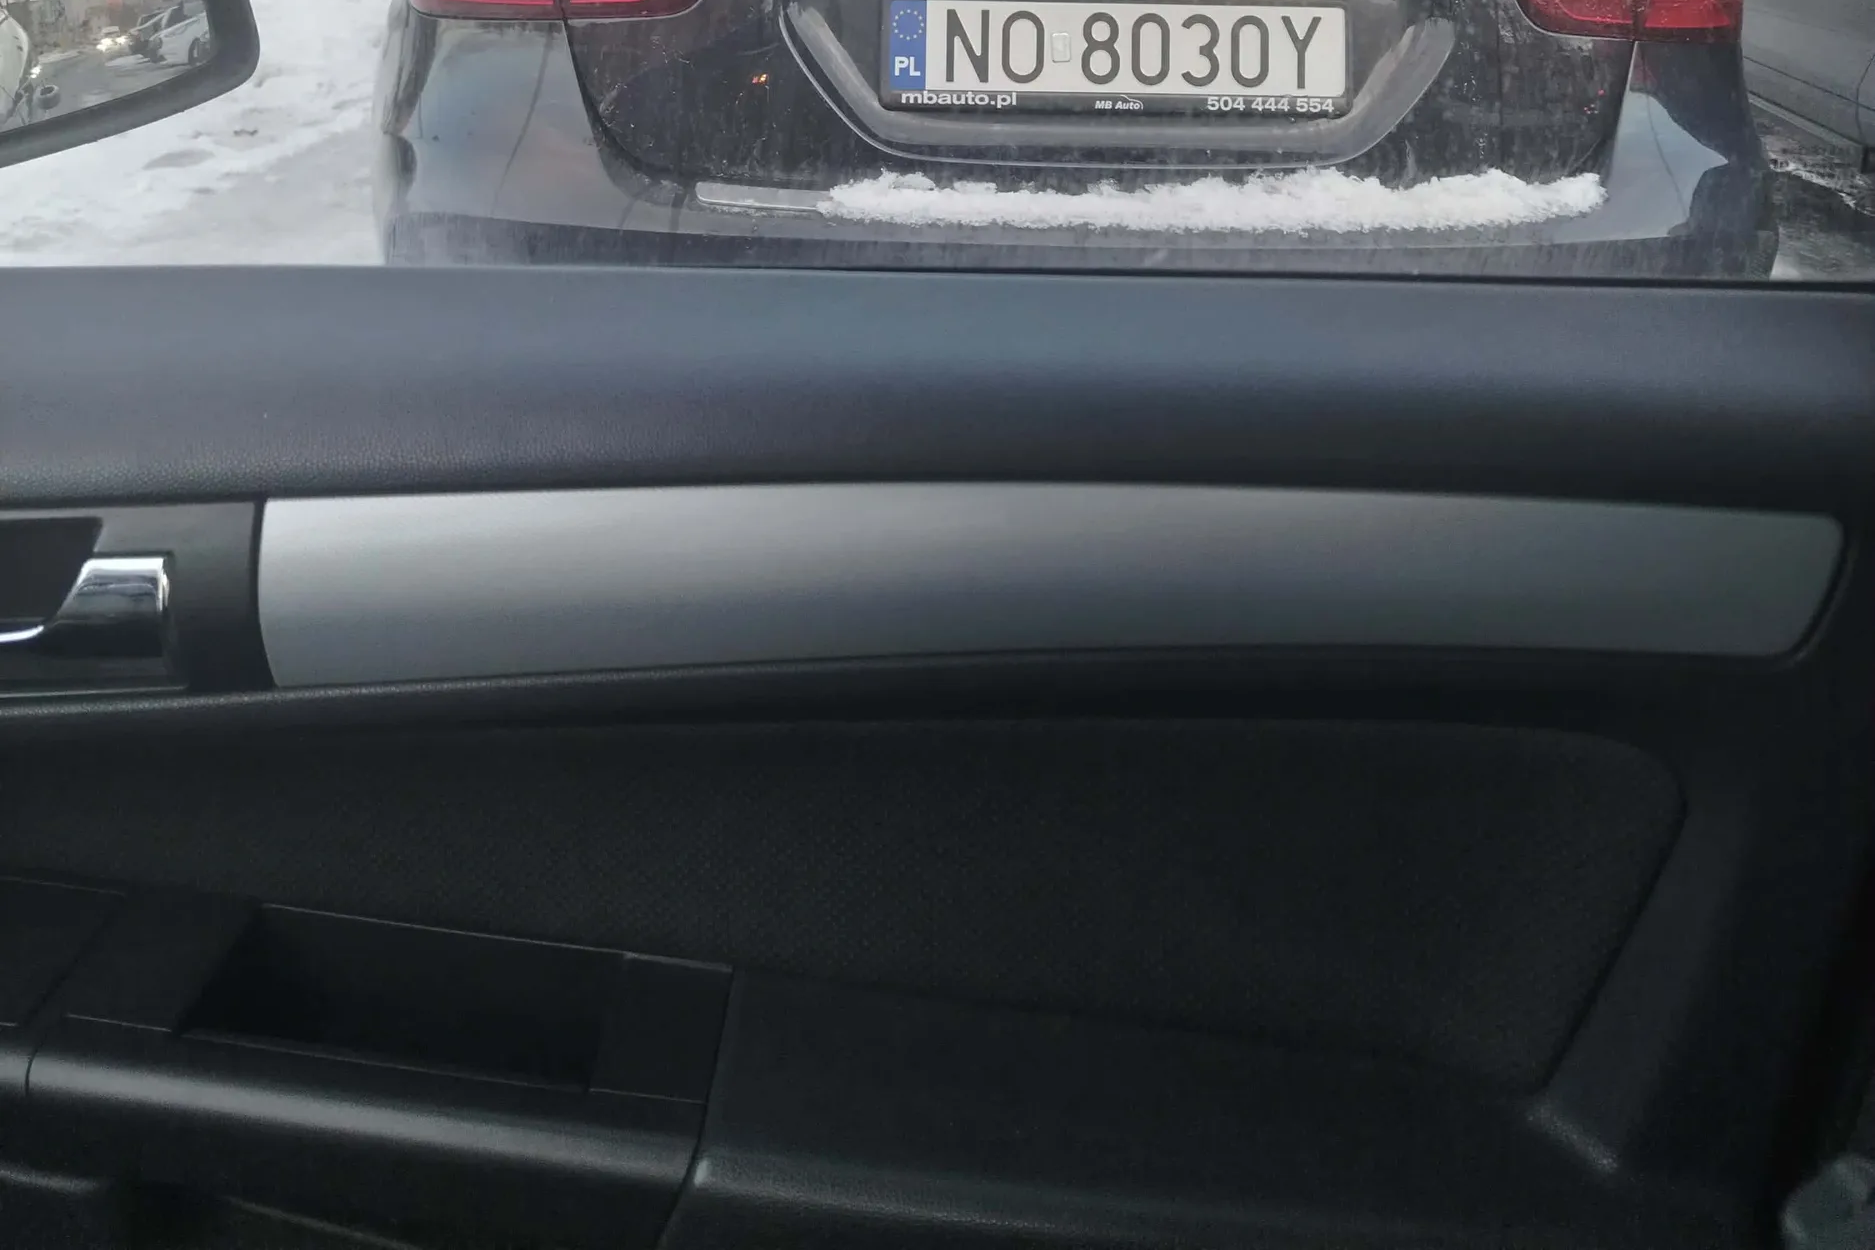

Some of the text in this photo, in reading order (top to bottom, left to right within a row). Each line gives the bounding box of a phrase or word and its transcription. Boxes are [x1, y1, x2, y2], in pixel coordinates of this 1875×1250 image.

[945, 8, 1322, 89] NO 8030Y
[894, 56, 921, 77] PL
[901, 90, 1017, 108] mbauto.pl
[1094, 100, 1140, 111] MB Auto
[1207, 96, 1334, 113] 504 444 554
